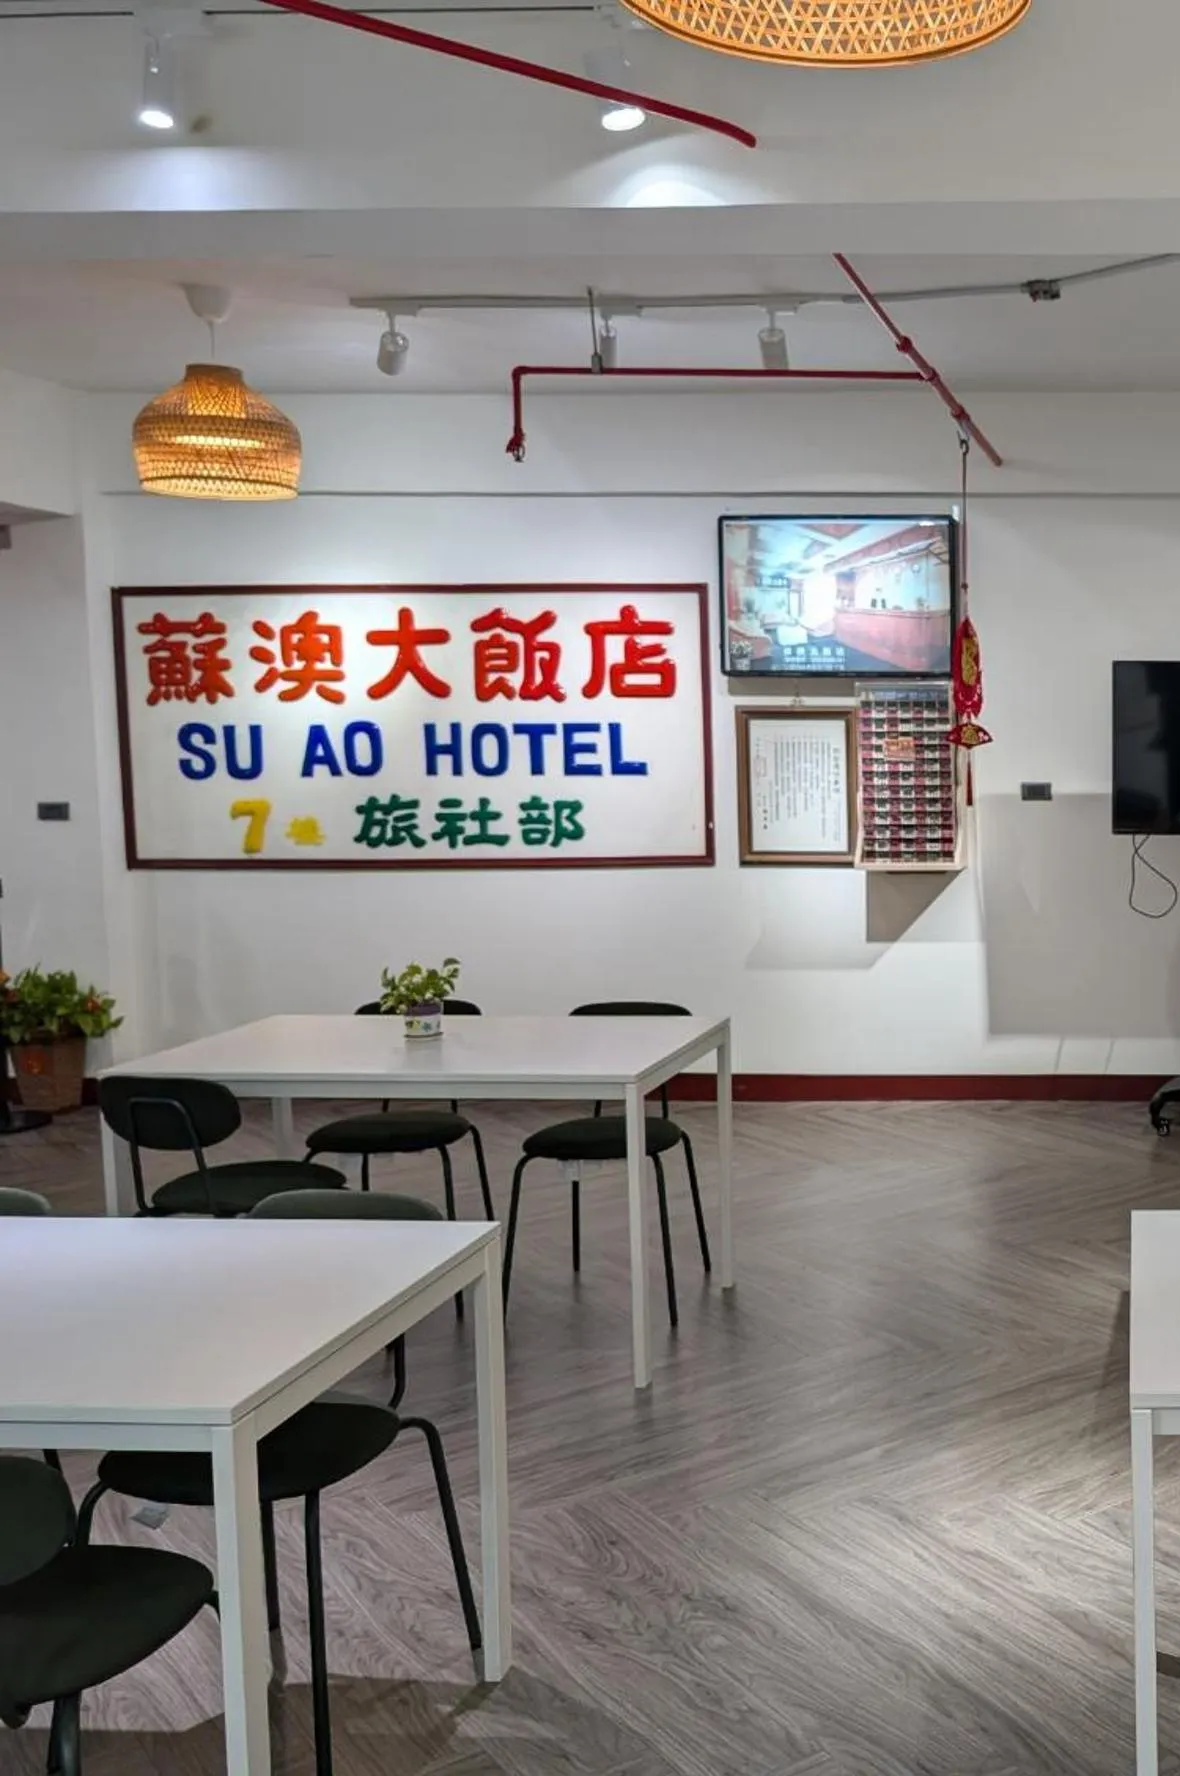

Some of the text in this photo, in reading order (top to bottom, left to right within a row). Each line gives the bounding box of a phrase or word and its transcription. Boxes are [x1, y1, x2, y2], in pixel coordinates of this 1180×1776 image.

[137, 605, 678, 705] 蘇澳大飯店
[178, 720, 648, 780] SU AO HOTEL
[354, 795, 585, 849] 旅社部
